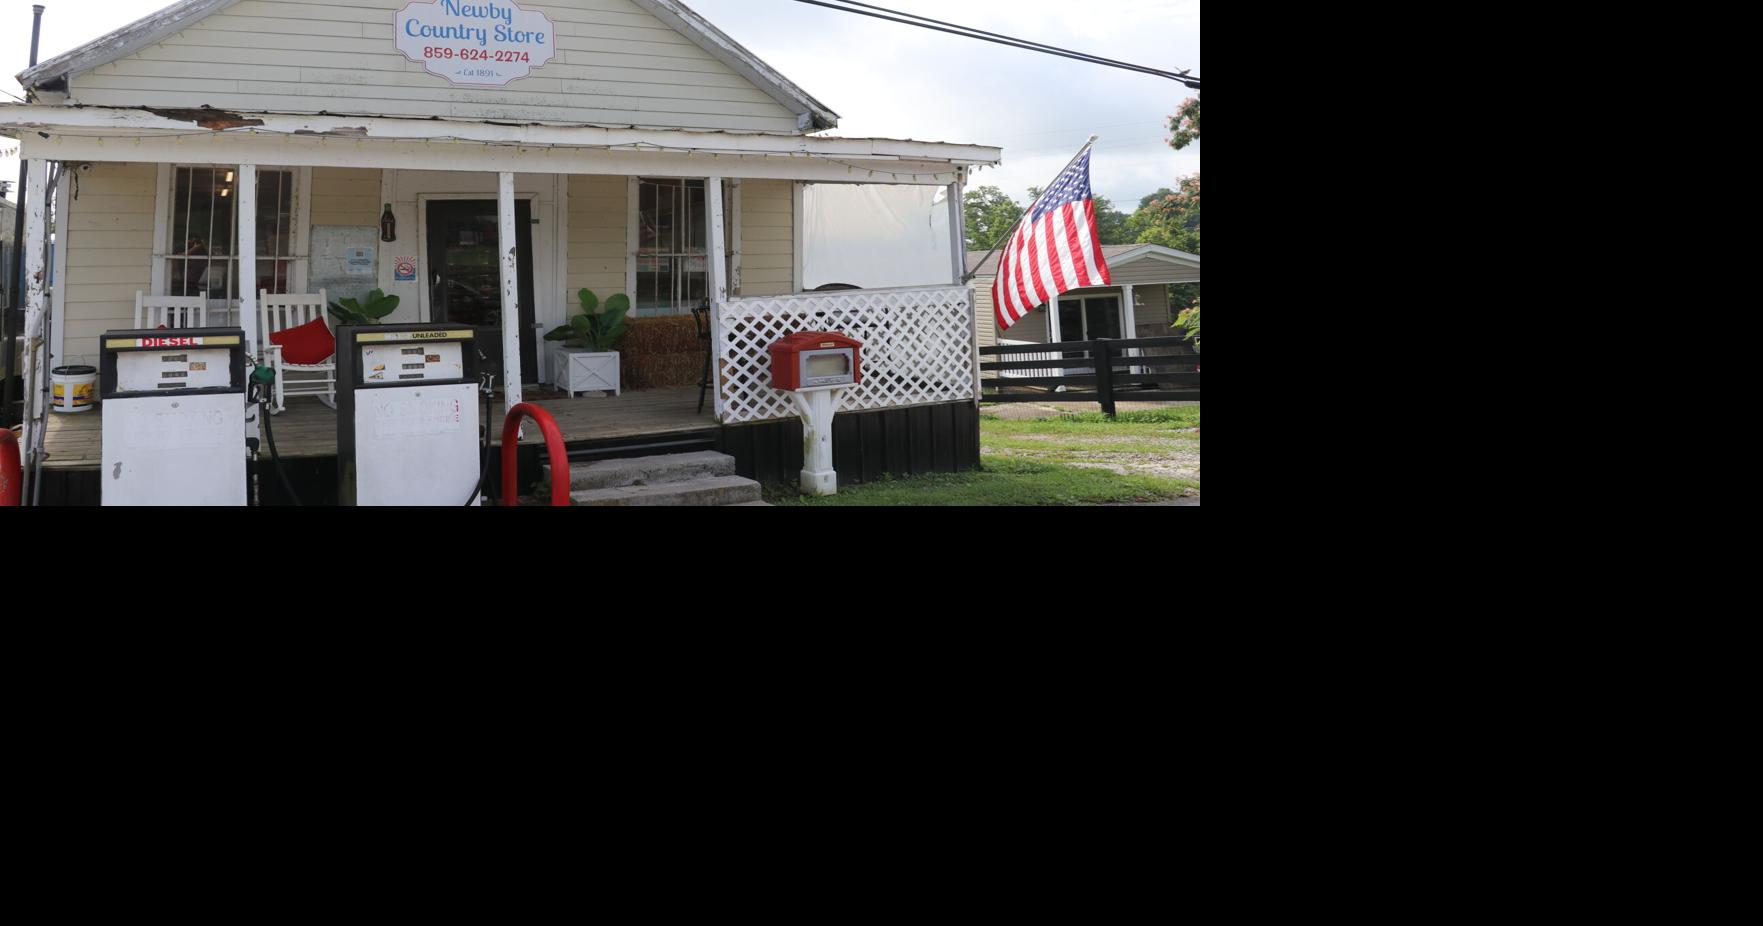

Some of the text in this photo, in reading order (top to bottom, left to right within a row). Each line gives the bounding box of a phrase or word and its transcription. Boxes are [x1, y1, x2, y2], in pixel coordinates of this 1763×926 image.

[440, 0, 512, 24] Newby
[405, 18, 545, 46] Country Store
[423, 46, 530, 63] 859-624-2274
[476, 69, 494, 78] 1891
[142, 337, 198, 347] DIESEL
